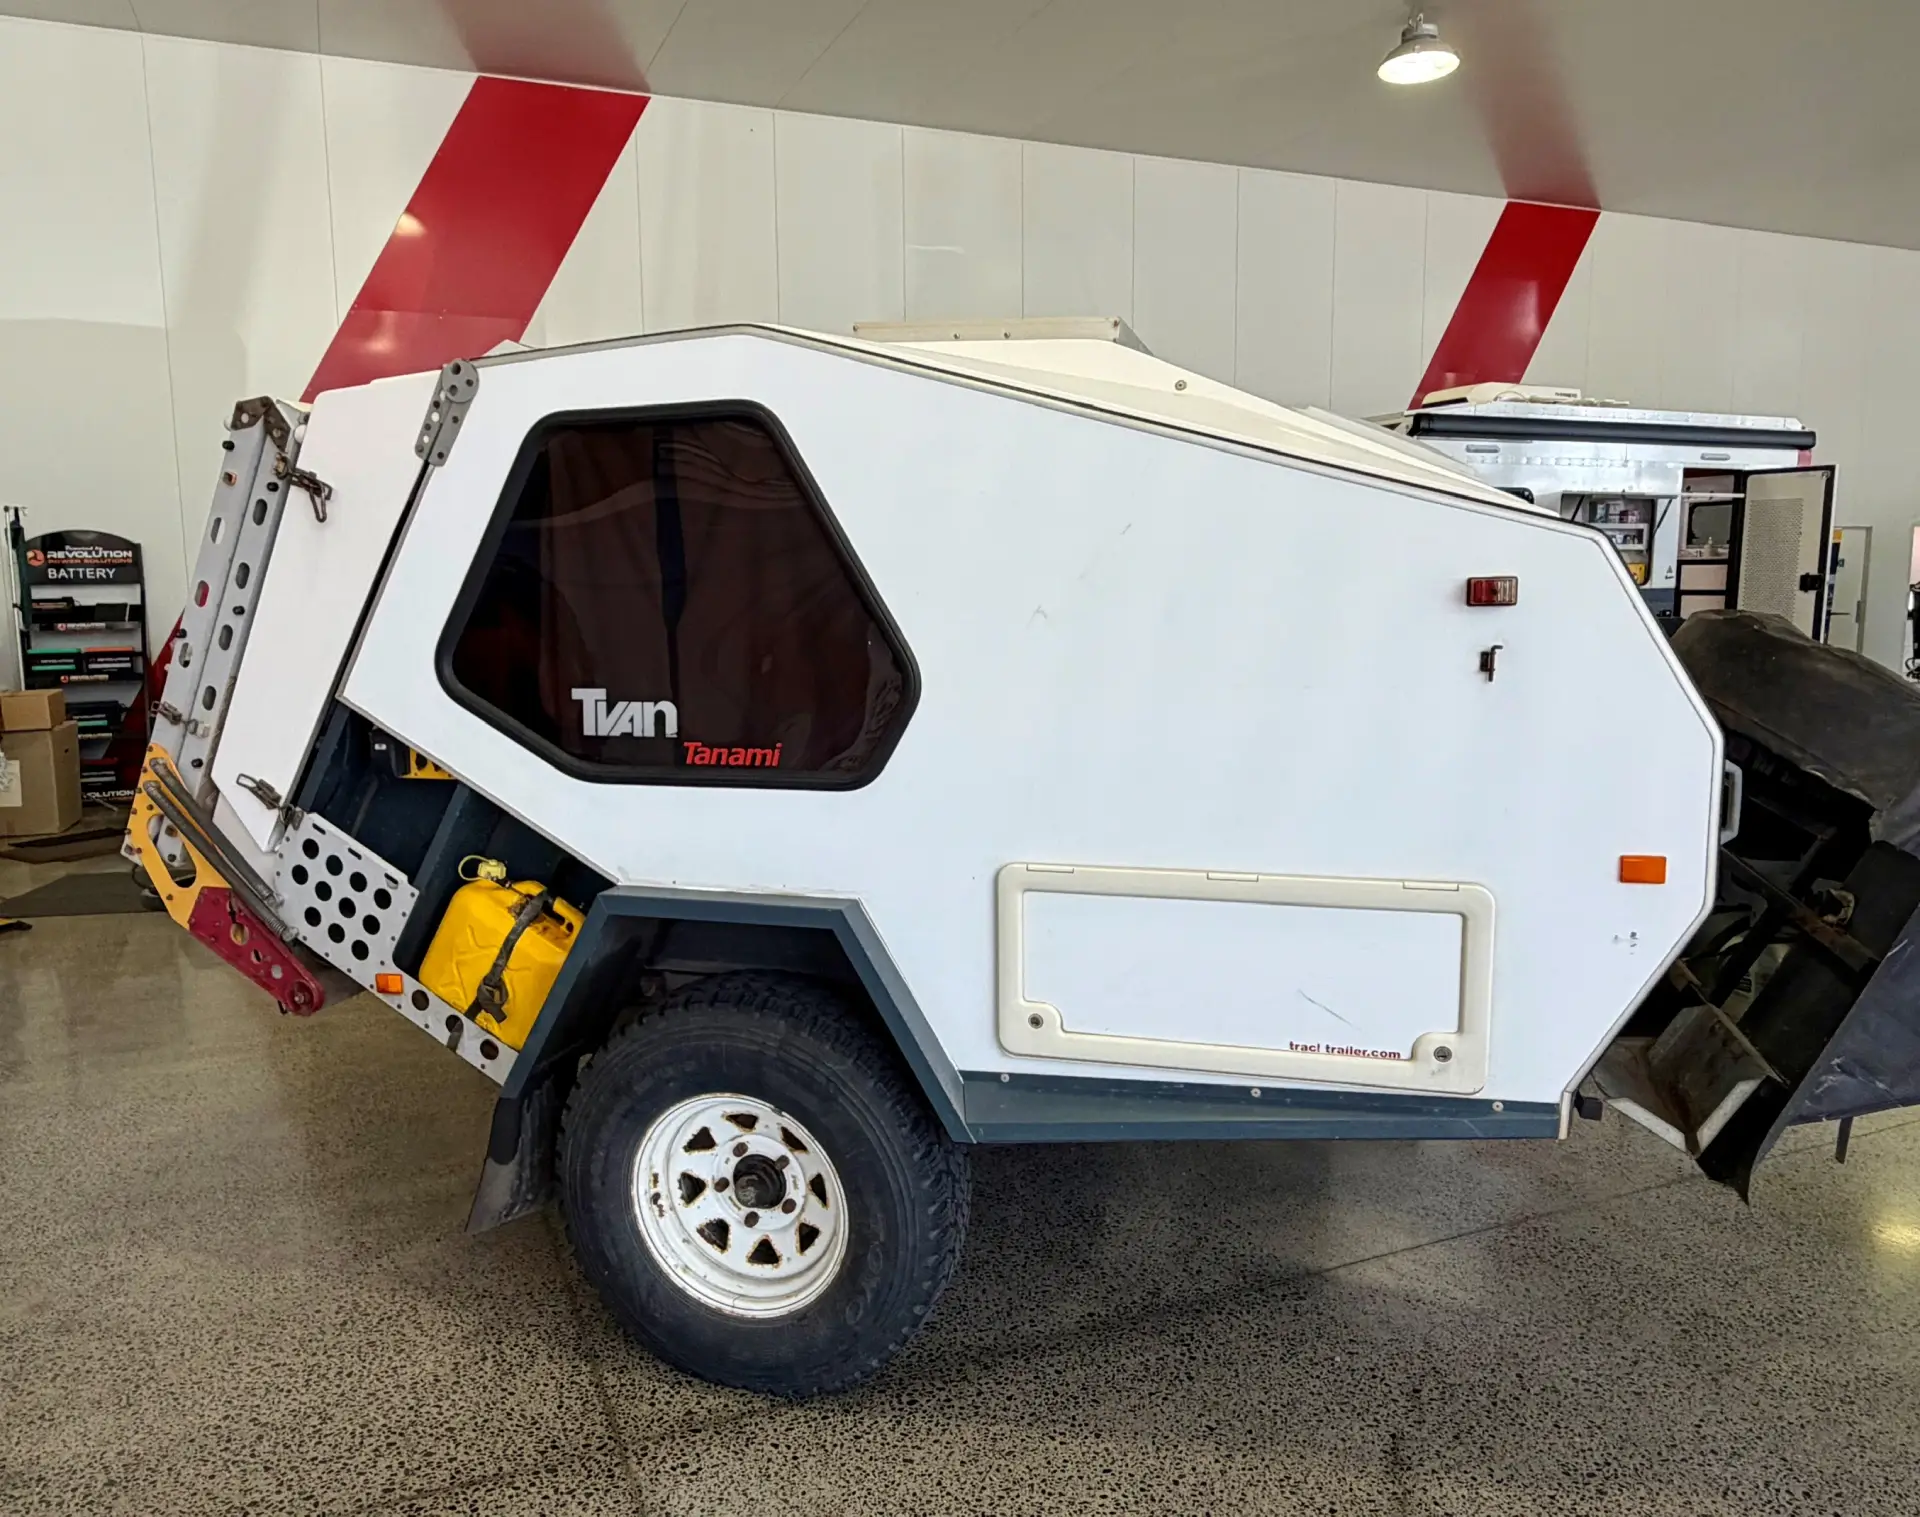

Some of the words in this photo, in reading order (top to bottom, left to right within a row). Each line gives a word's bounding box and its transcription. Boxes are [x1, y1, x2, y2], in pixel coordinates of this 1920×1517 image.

[47, 550, 132, 558] REVOLUTION
[48, 567, 116, 579] BATTERY
[683, 741, 783, 767] Tanami
